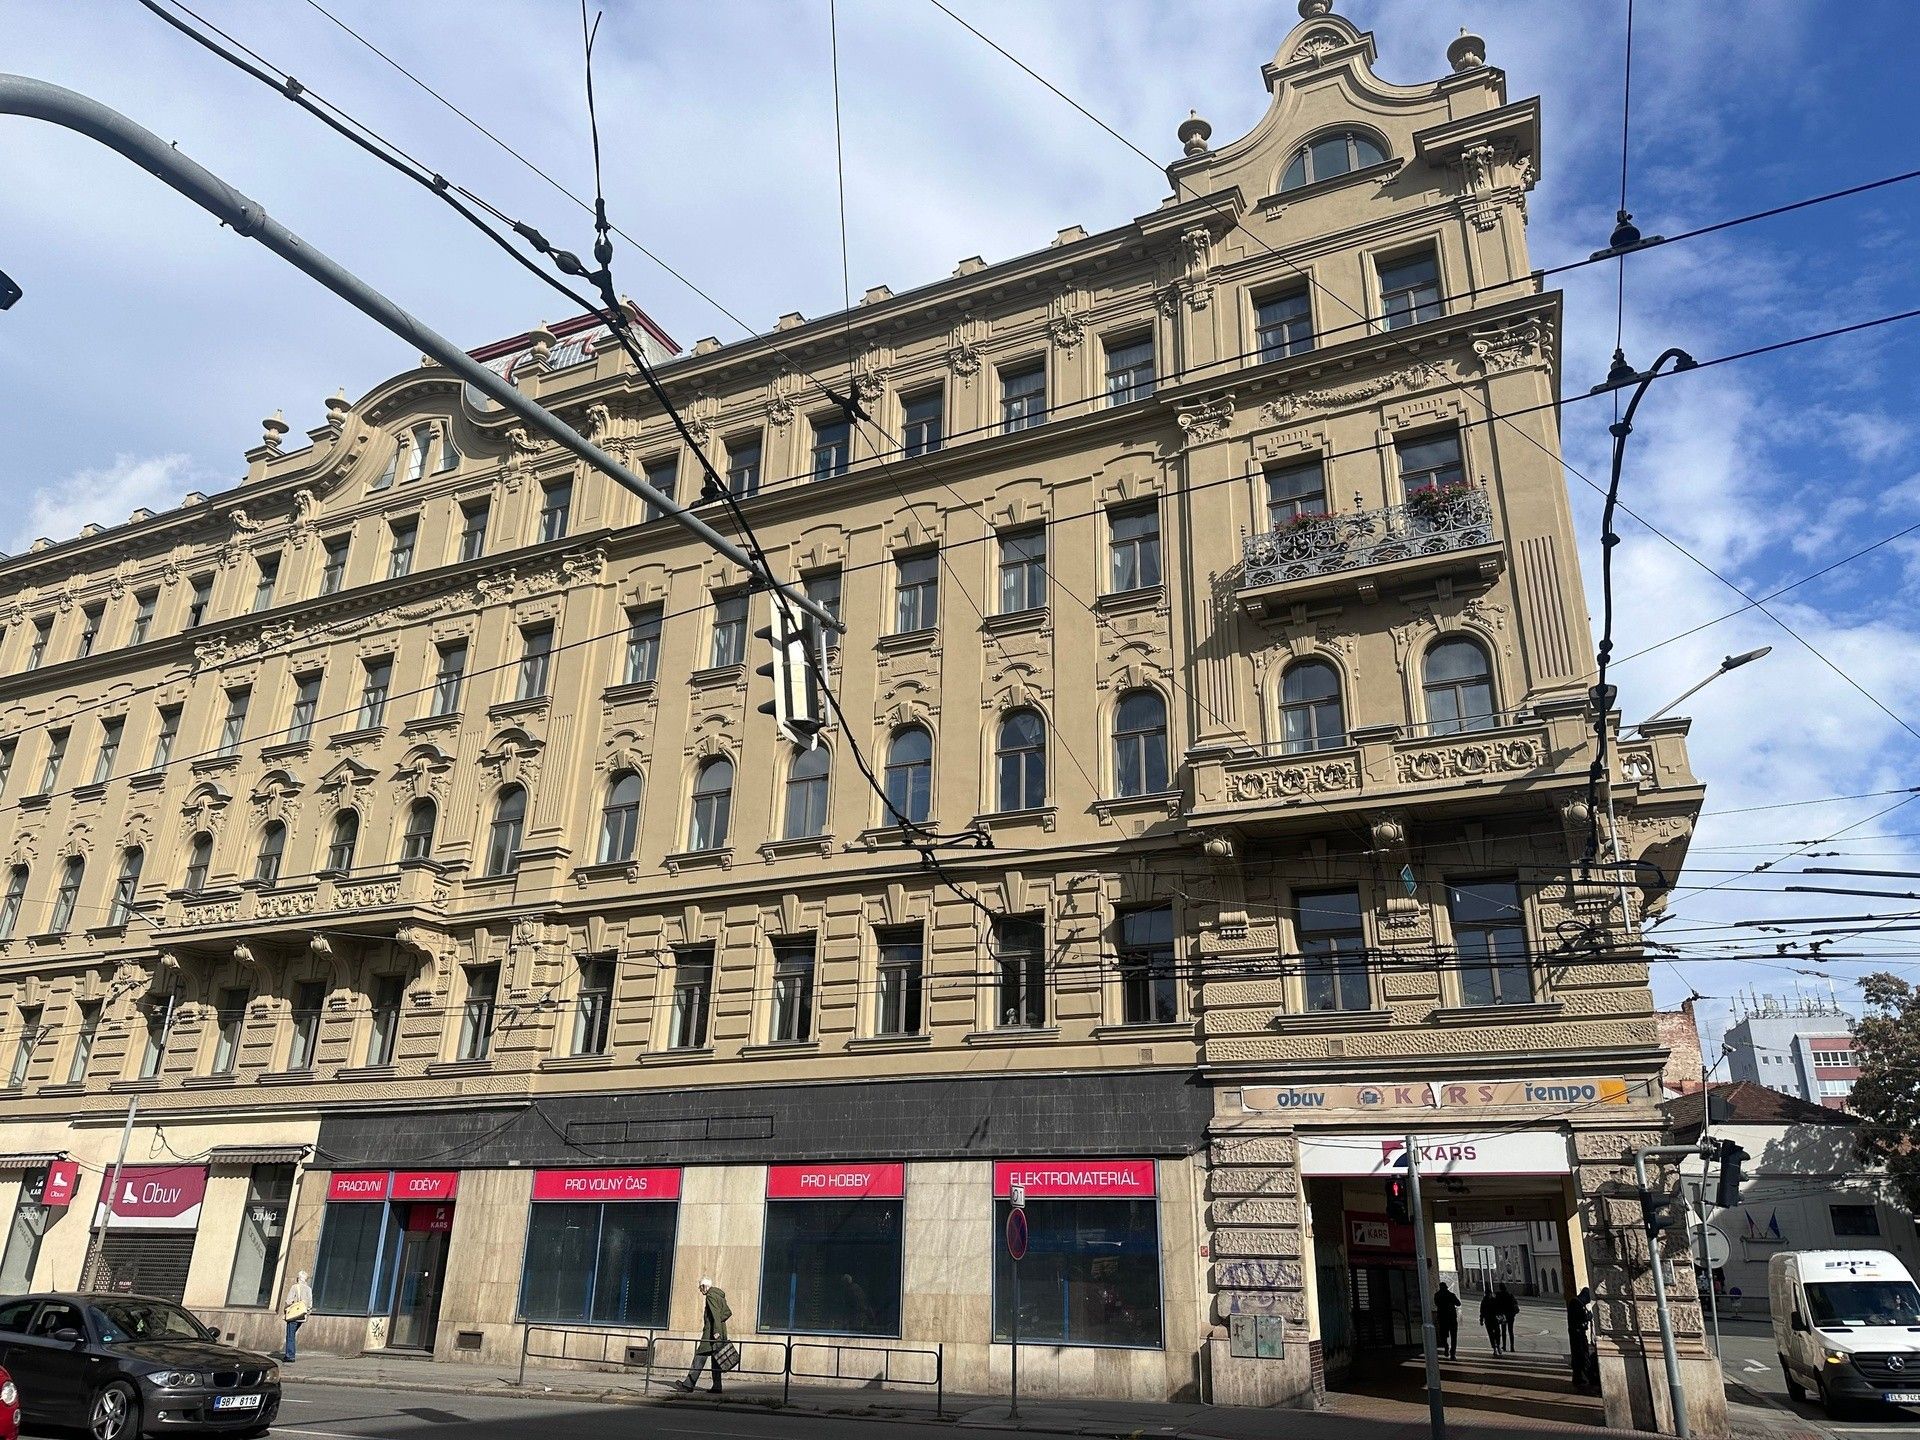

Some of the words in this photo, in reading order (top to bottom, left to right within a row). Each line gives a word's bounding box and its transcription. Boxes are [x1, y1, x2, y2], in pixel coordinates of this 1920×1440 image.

[1277, 1088, 1325, 1107] obuv
[1524, 1082, 1596, 1103] řempo
[1420, 1146, 1477, 1161] KARS
[337, 1177, 384, 1192] PRACOVNÍ
[409, 1177, 441, 1191] ODĚVY
[565, 1178, 587, 1191] PRO
[588, 1176, 624, 1191] VOLNÝ
[624, 1175, 648, 1190] ČAS
[801, 1174, 826, 1188] PRO
[828, 1173, 871, 1187] HOBBY
[1010, 1168, 1140, 1186] ELEKTROMATERIÁL
[50, 1190, 65, 1198] Obuv
[142, 1182, 182, 1203] Obuv
[430, 1221, 448, 1229] KARS
[1367, 1228, 1388, 1240] KARS
